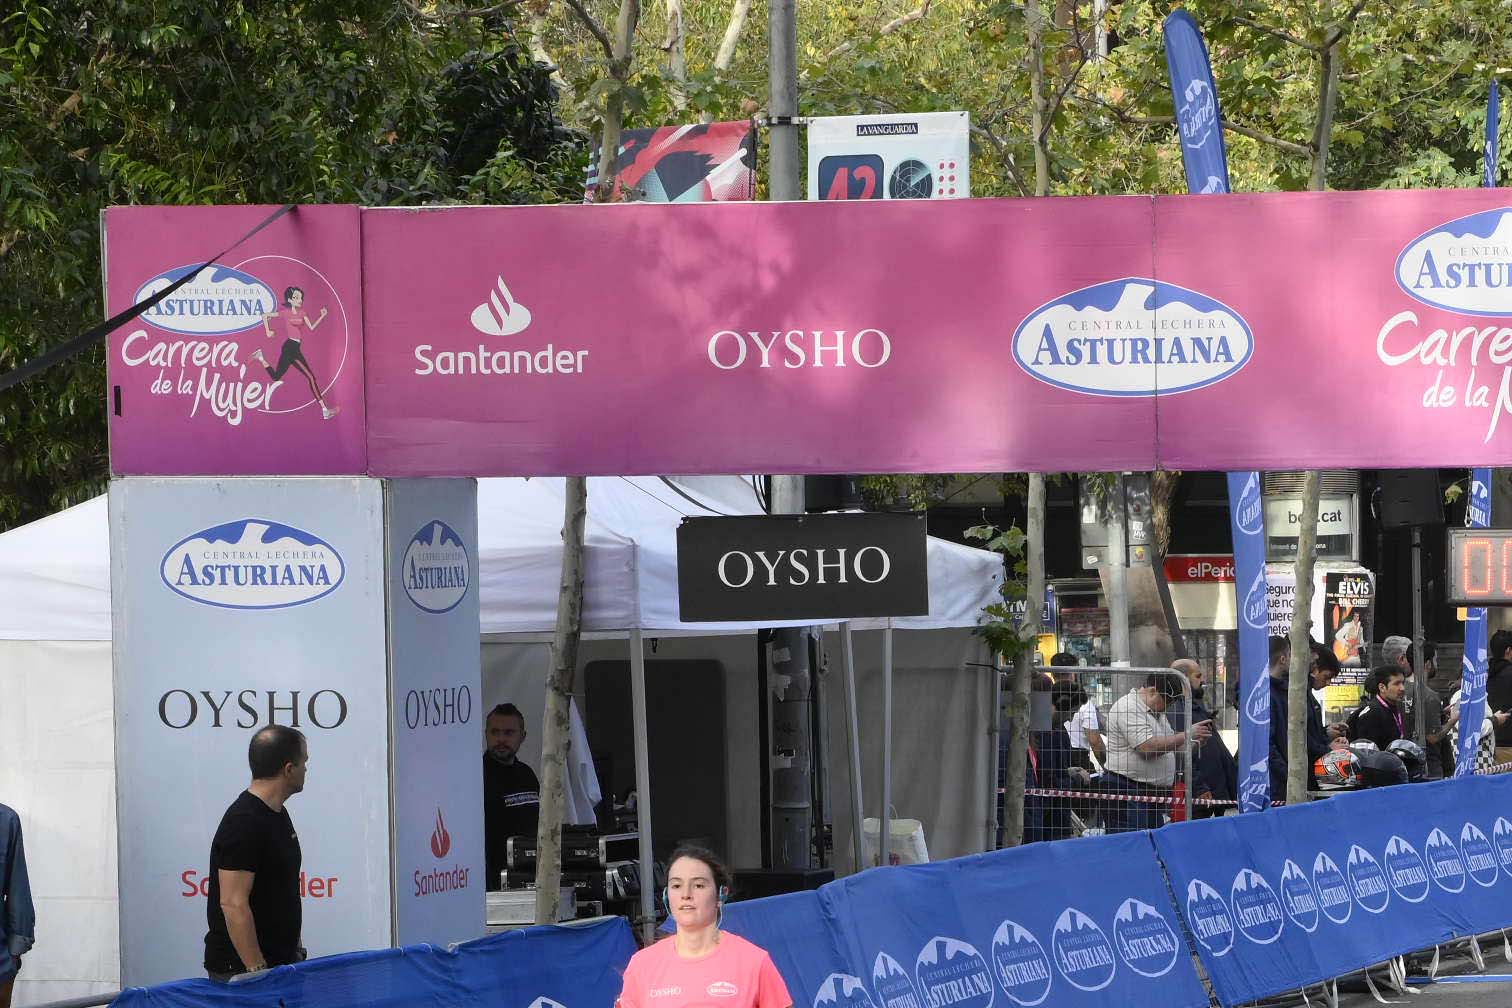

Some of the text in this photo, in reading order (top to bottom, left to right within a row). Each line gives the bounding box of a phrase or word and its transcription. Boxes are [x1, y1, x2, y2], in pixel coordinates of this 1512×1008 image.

[858, 124, 917, 135] LA VANGUARDIA
[173, 287, 261, 296] ENTRAL LECHERA
[1068, 319, 1228, 331] CENTRAL LECHERA
[121, 330, 239, 367] Carrera
[414, 344, 589, 375] Santander
[707, 328, 891, 370] OYSHO
[1031, 321, 1235, 367] ASTURIANA
[150, 365, 284, 426] de la Mujer
[1423, 367, 1456, 408] de
[1464, 367, 1490, 408] la
[175, 553, 332, 587] ASTURIANA
[203, 550, 325, 560] CENTRAL LECHERA
[717, 546, 891, 588] OYSHO
[408, 558, 466, 590] ASTURIANA
[1339, 581, 1369, 594] ELVIS
[158, 689, 348, 729] OYSHO
[405, 684, 472, 730] OYSHO
[414, 866, 470, 897] Santander
[997, 955, 1049, 988] ASTURIANA
